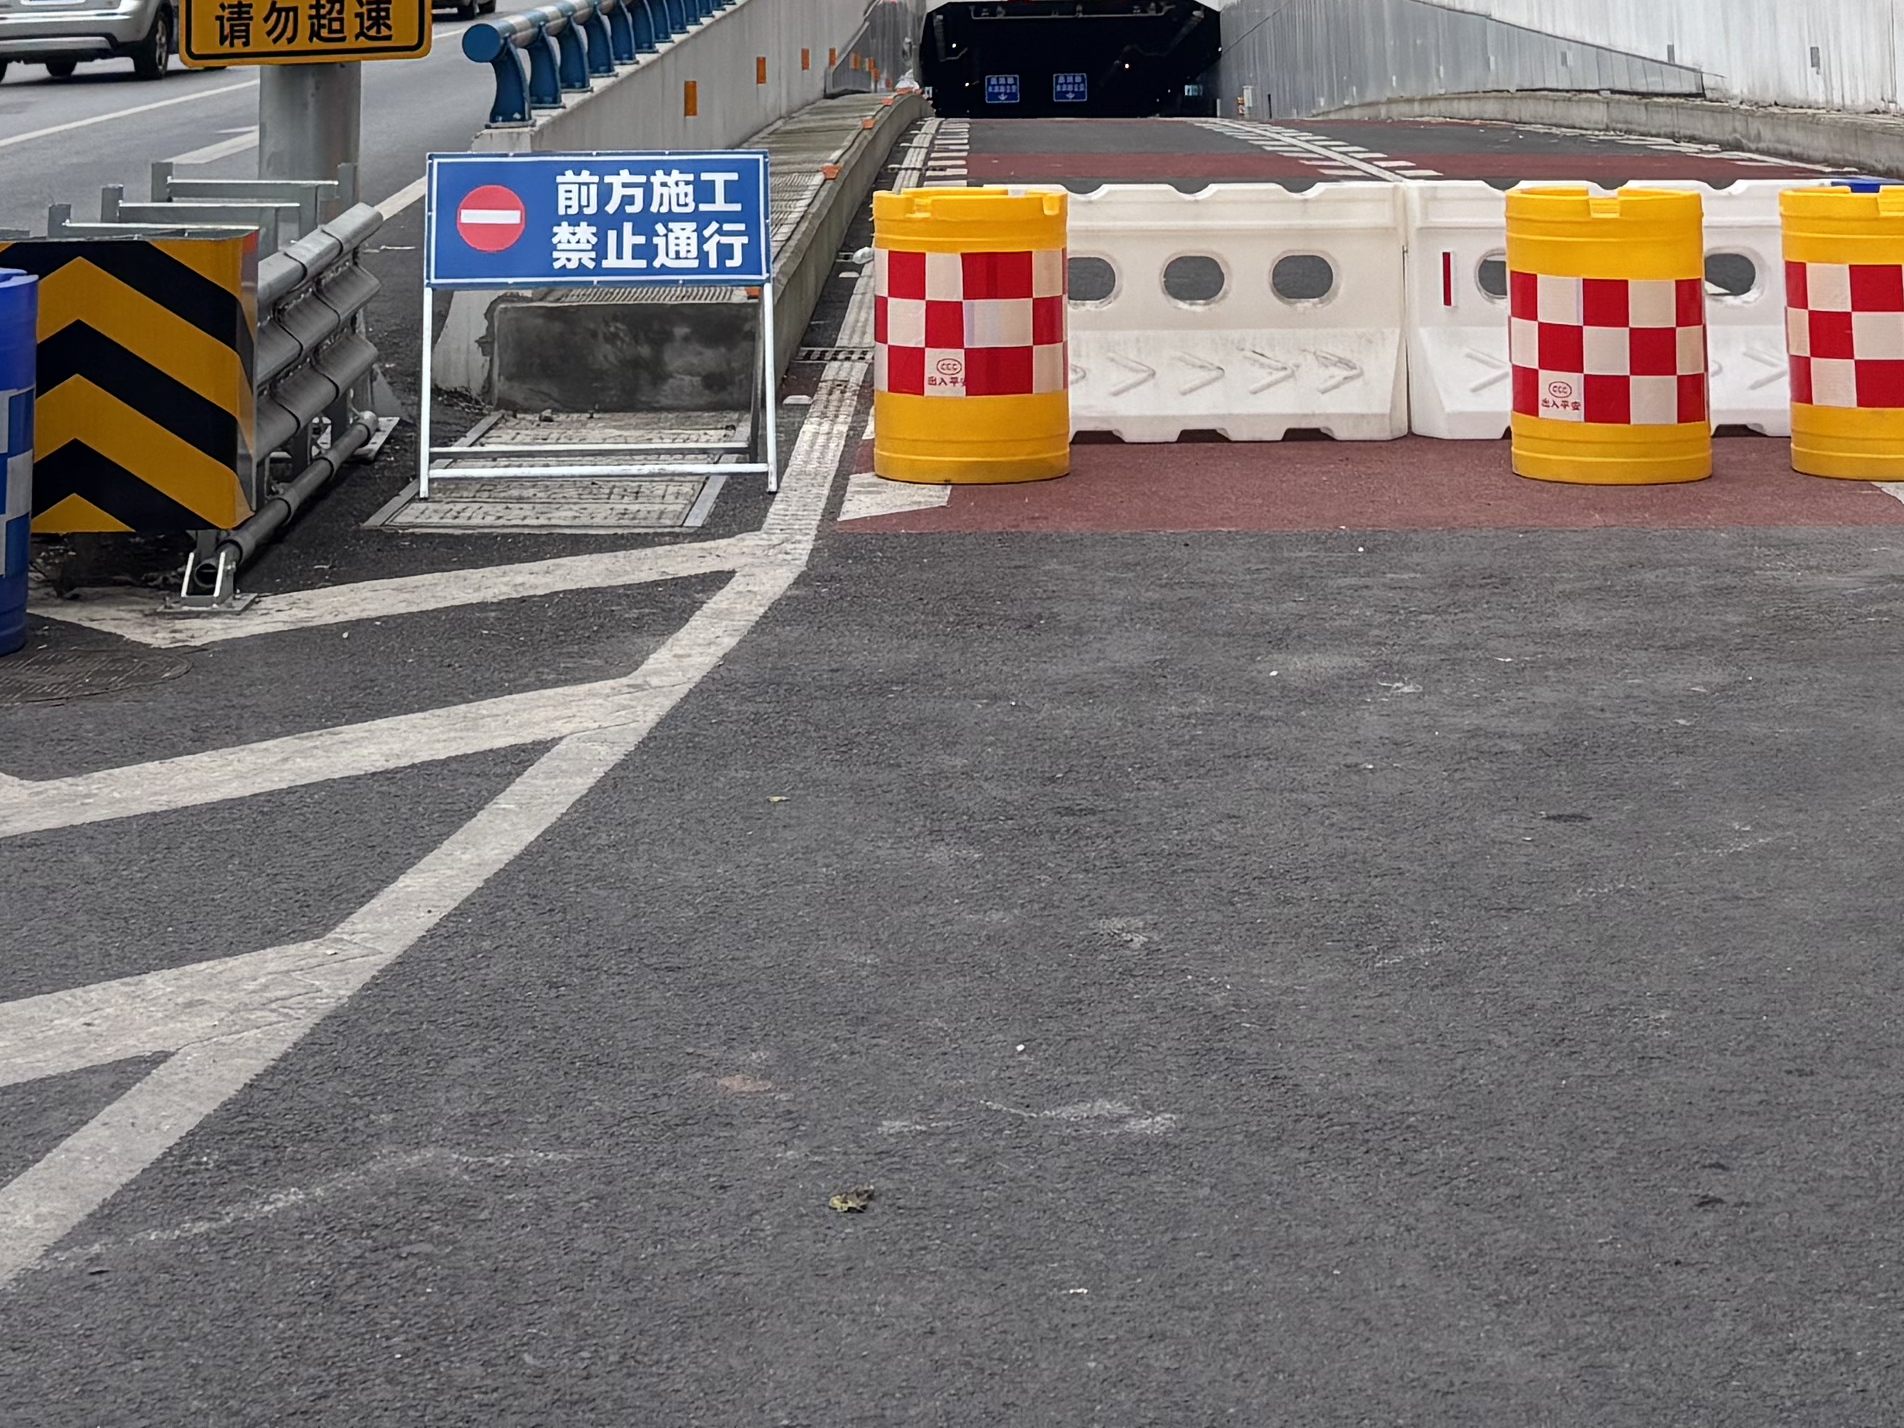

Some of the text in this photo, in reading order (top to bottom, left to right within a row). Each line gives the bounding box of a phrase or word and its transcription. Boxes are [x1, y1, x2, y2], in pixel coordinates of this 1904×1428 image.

[555, 169, 743, 216] 前方施工
[550, 220, 749, 270] 禁止通行
